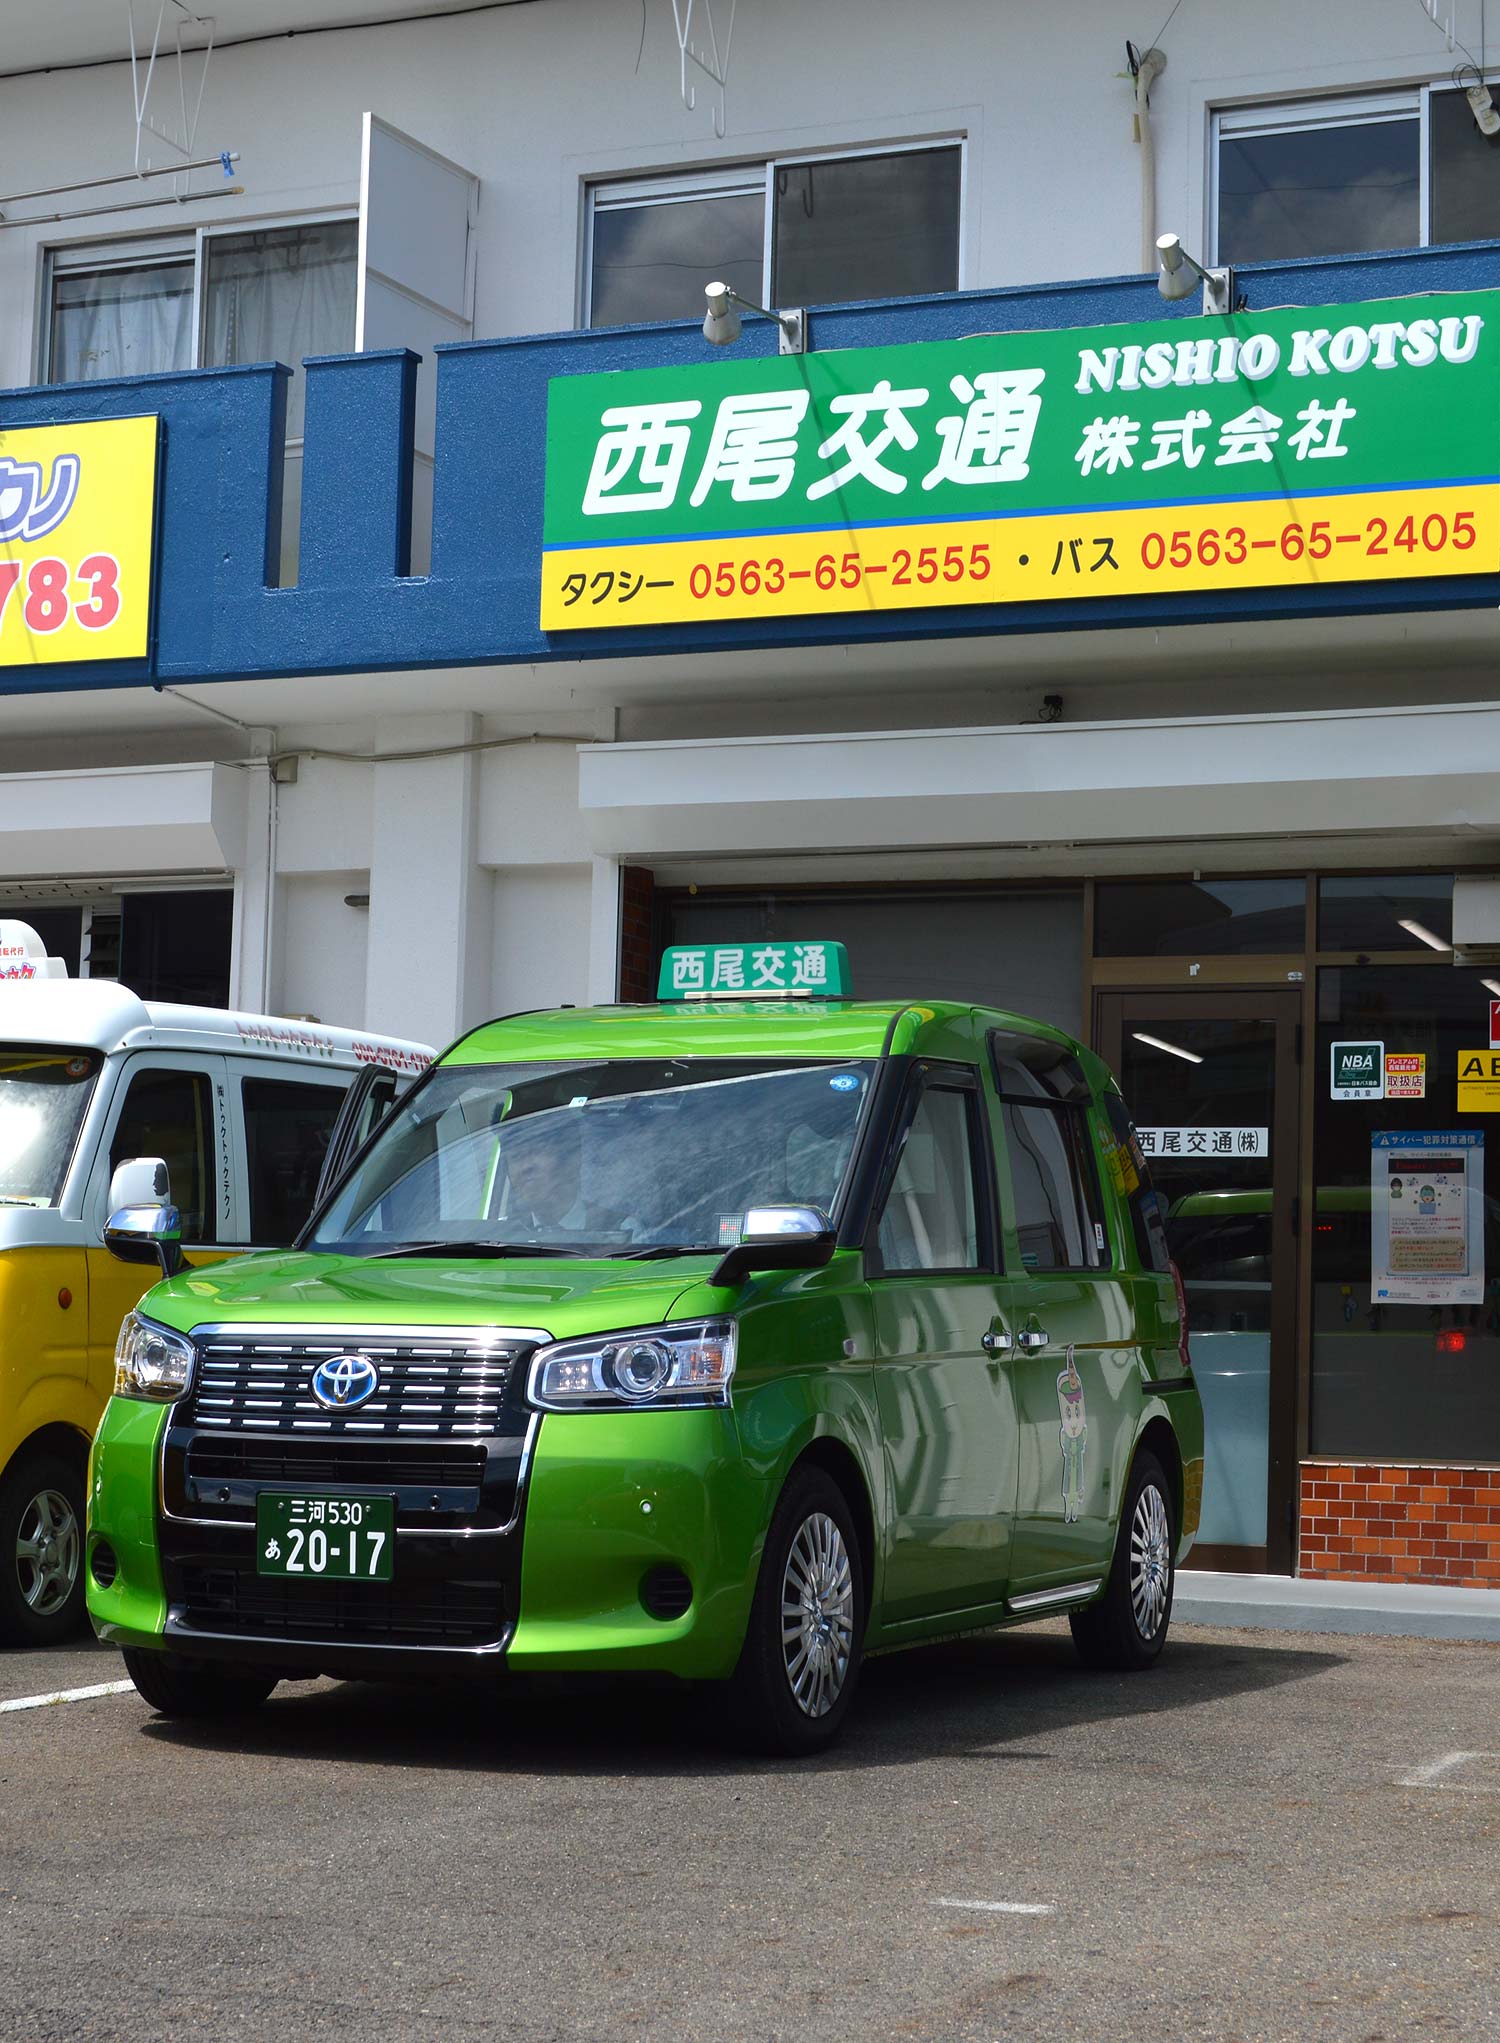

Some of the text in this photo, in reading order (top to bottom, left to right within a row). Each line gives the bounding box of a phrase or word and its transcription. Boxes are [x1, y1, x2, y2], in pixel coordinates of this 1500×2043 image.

[1074, 315, 1484, 394] NISHIO KOTSU
[582, 368, 1046, 516] 西尾交通
[1074, 397, 1356, 477] 株式会社
[561, 570, 675, 607] タクシー
[689, 543, 992, 599] 0563-65-2555
[1140, 511, 1477, 571] 0563-65-2405
[671, 945, 827, 989] 西尾交通
[1342, 1054, 1373, 1068] NBA
[1387, 1075, 1422, 1087] 取扱店
[1391, 1134, 1476, 1146] サイバー犯罪対策通信
